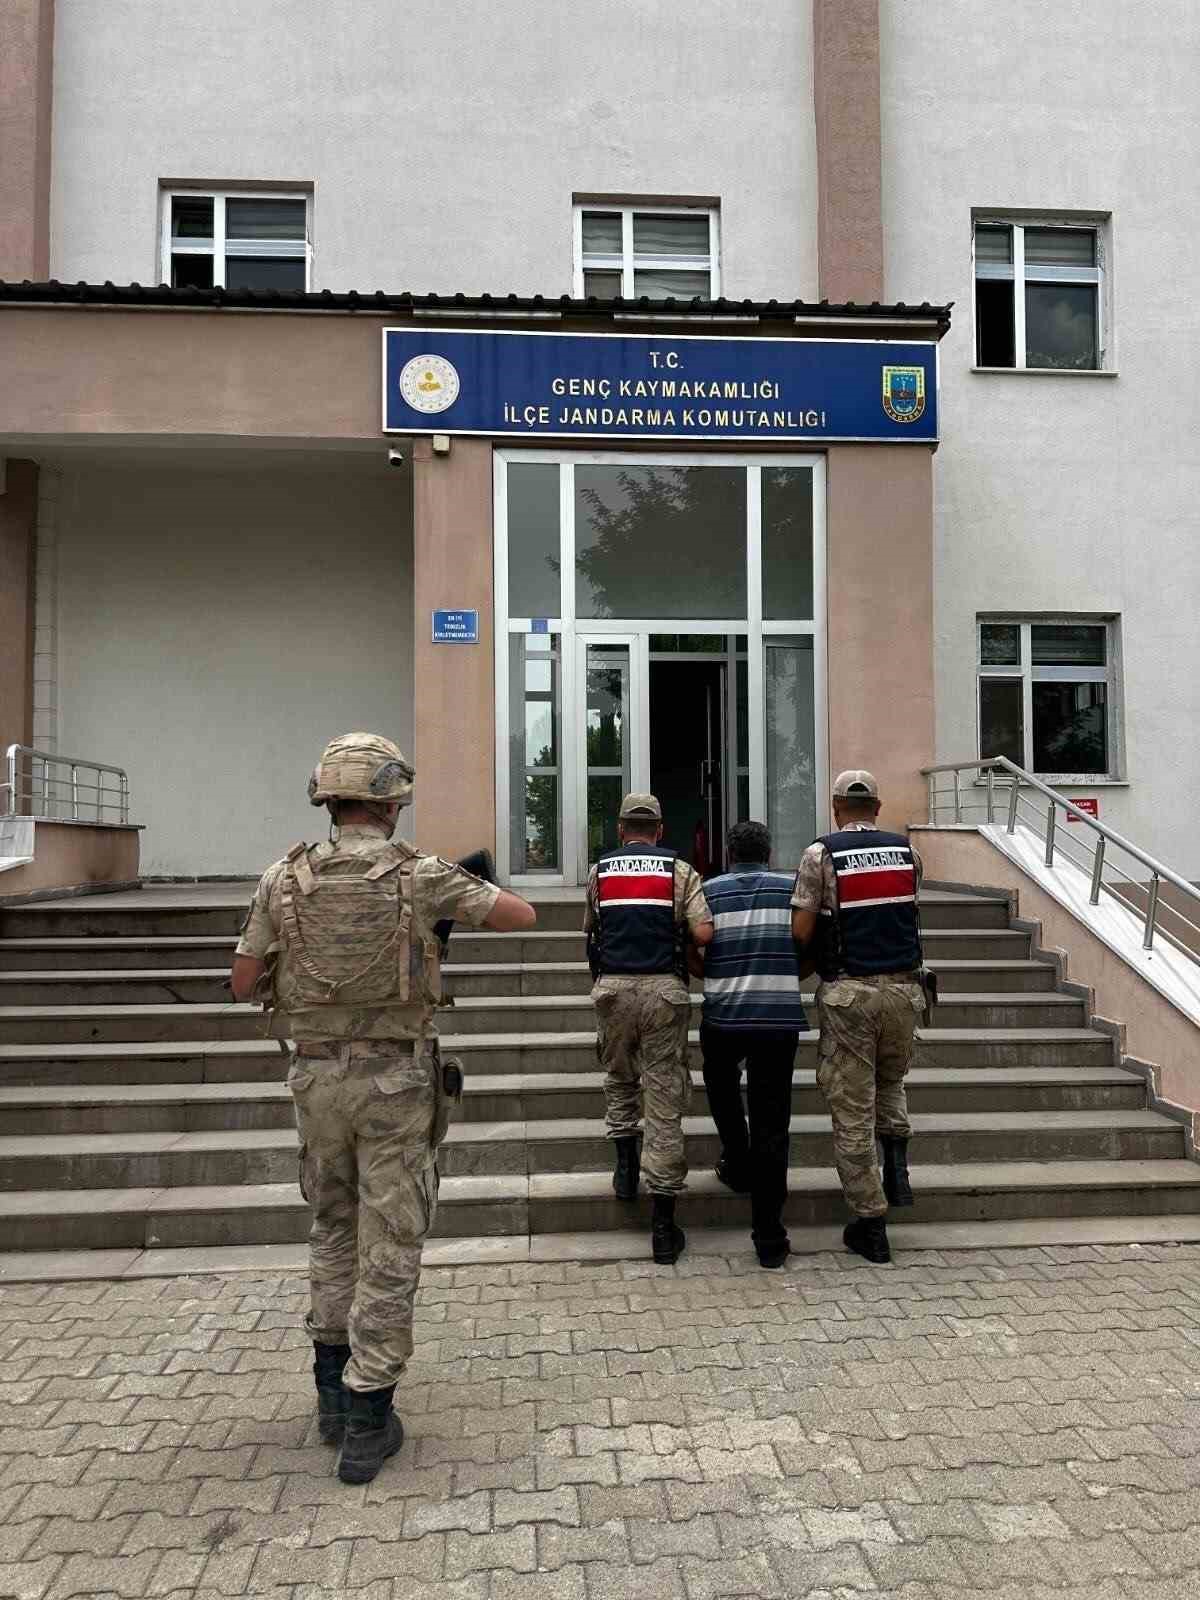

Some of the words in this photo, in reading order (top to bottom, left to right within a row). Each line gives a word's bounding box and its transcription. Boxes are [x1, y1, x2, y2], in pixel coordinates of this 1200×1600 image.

[649, 351, 684, 369] T.C.
[552, 378, 611, 399] GENÇ
[619, 381, 780, 399] KAYMAKAMLIĞI
[504, 403, 550, 426] İLÇE
[559, 407, 676, 426] JANDARMA
[683, 408, 826, 428] KOMUTANLIĞI
[606, 860, 665, 873] JANDARMA
[845, 851, 905, 870] JANDARMA
